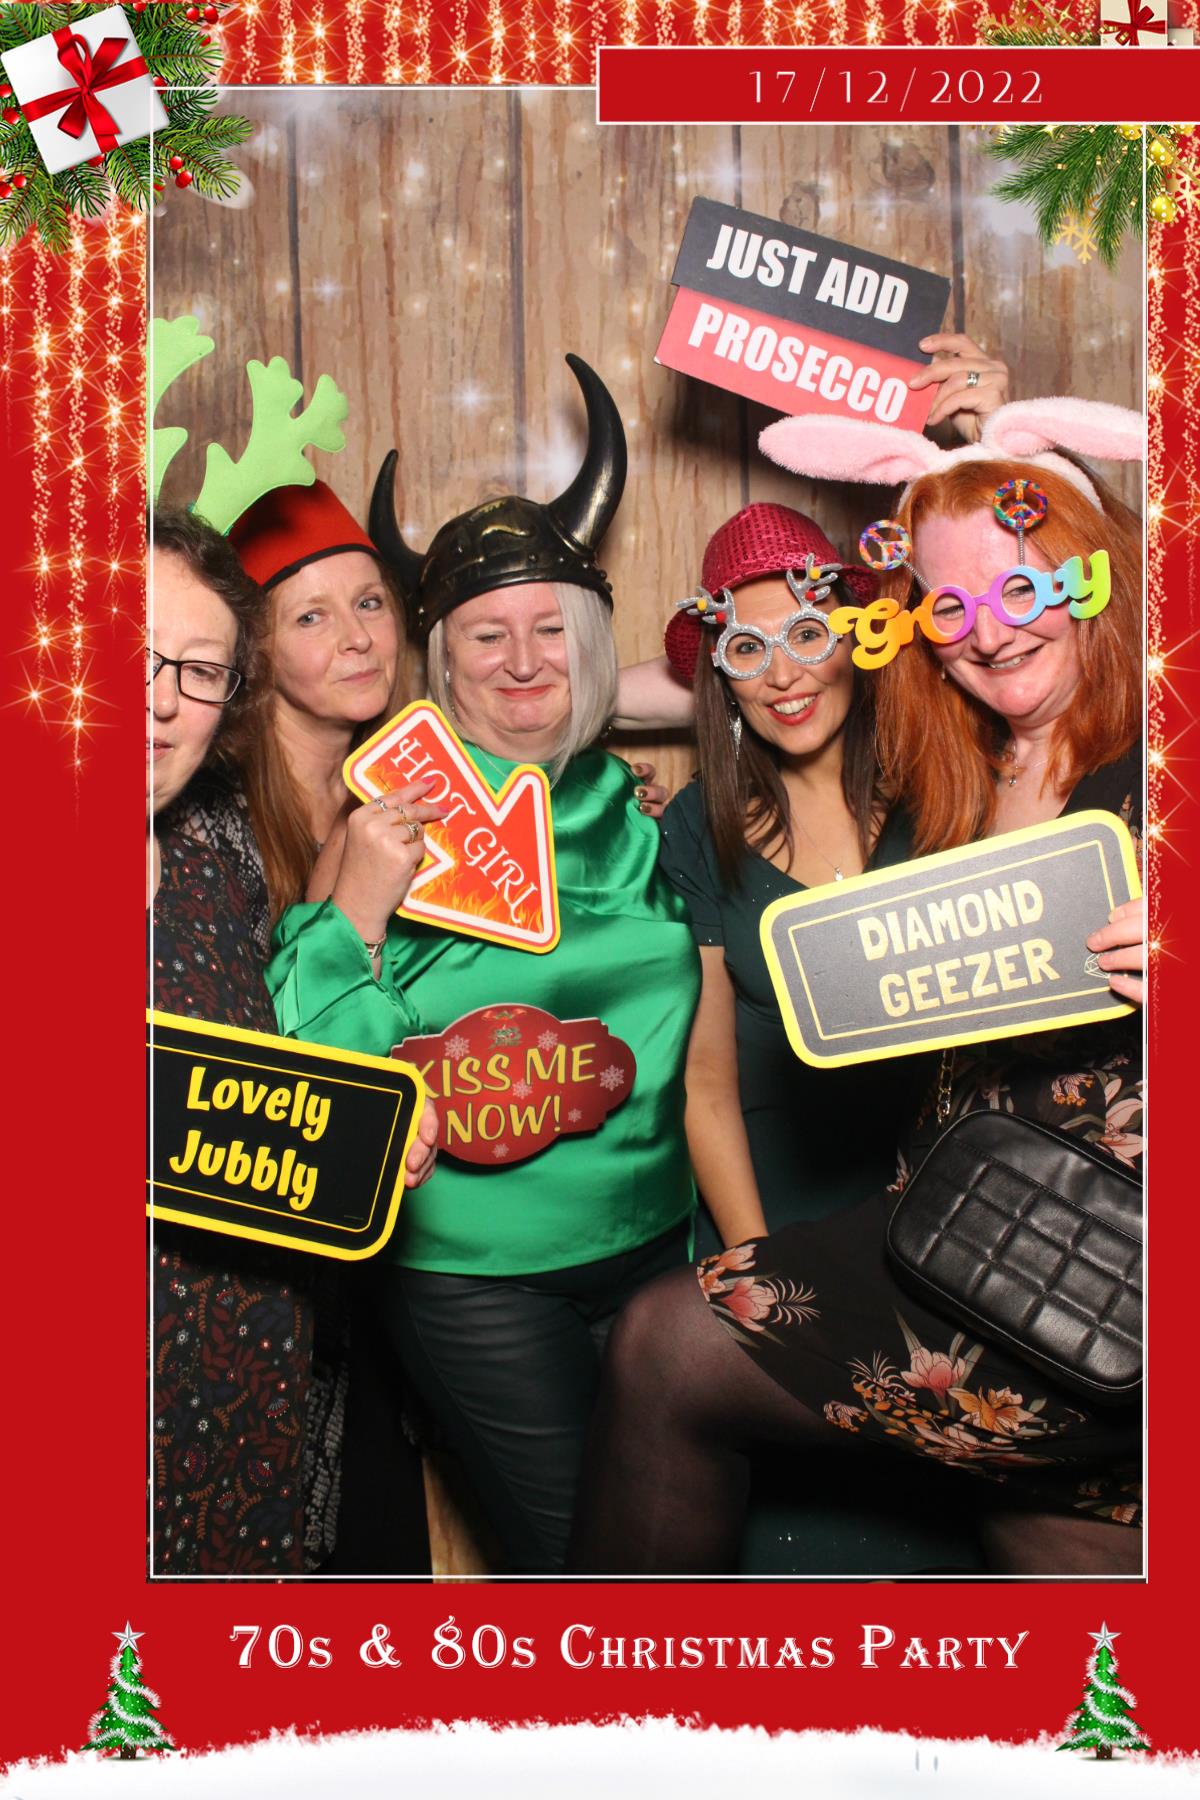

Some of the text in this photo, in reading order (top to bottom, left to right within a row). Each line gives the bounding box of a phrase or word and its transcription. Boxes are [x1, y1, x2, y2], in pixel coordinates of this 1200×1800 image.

[706, 224, 909, 324] JUST ADD
[688, 303, 908, 423] PROSECCO
[390, 737, 538, 924] HOT GIRL
[857, 879, 1044, 961] DIAMOND
[879, 938, 1060, 1018] GEEZER
[187, 1066, 331, 1142] Lovely
[525, 1043, 596, 1085] ME
[446, 1095, 562, 1145] NOW!
[169, 1130, 318, 1211] Jubbly
